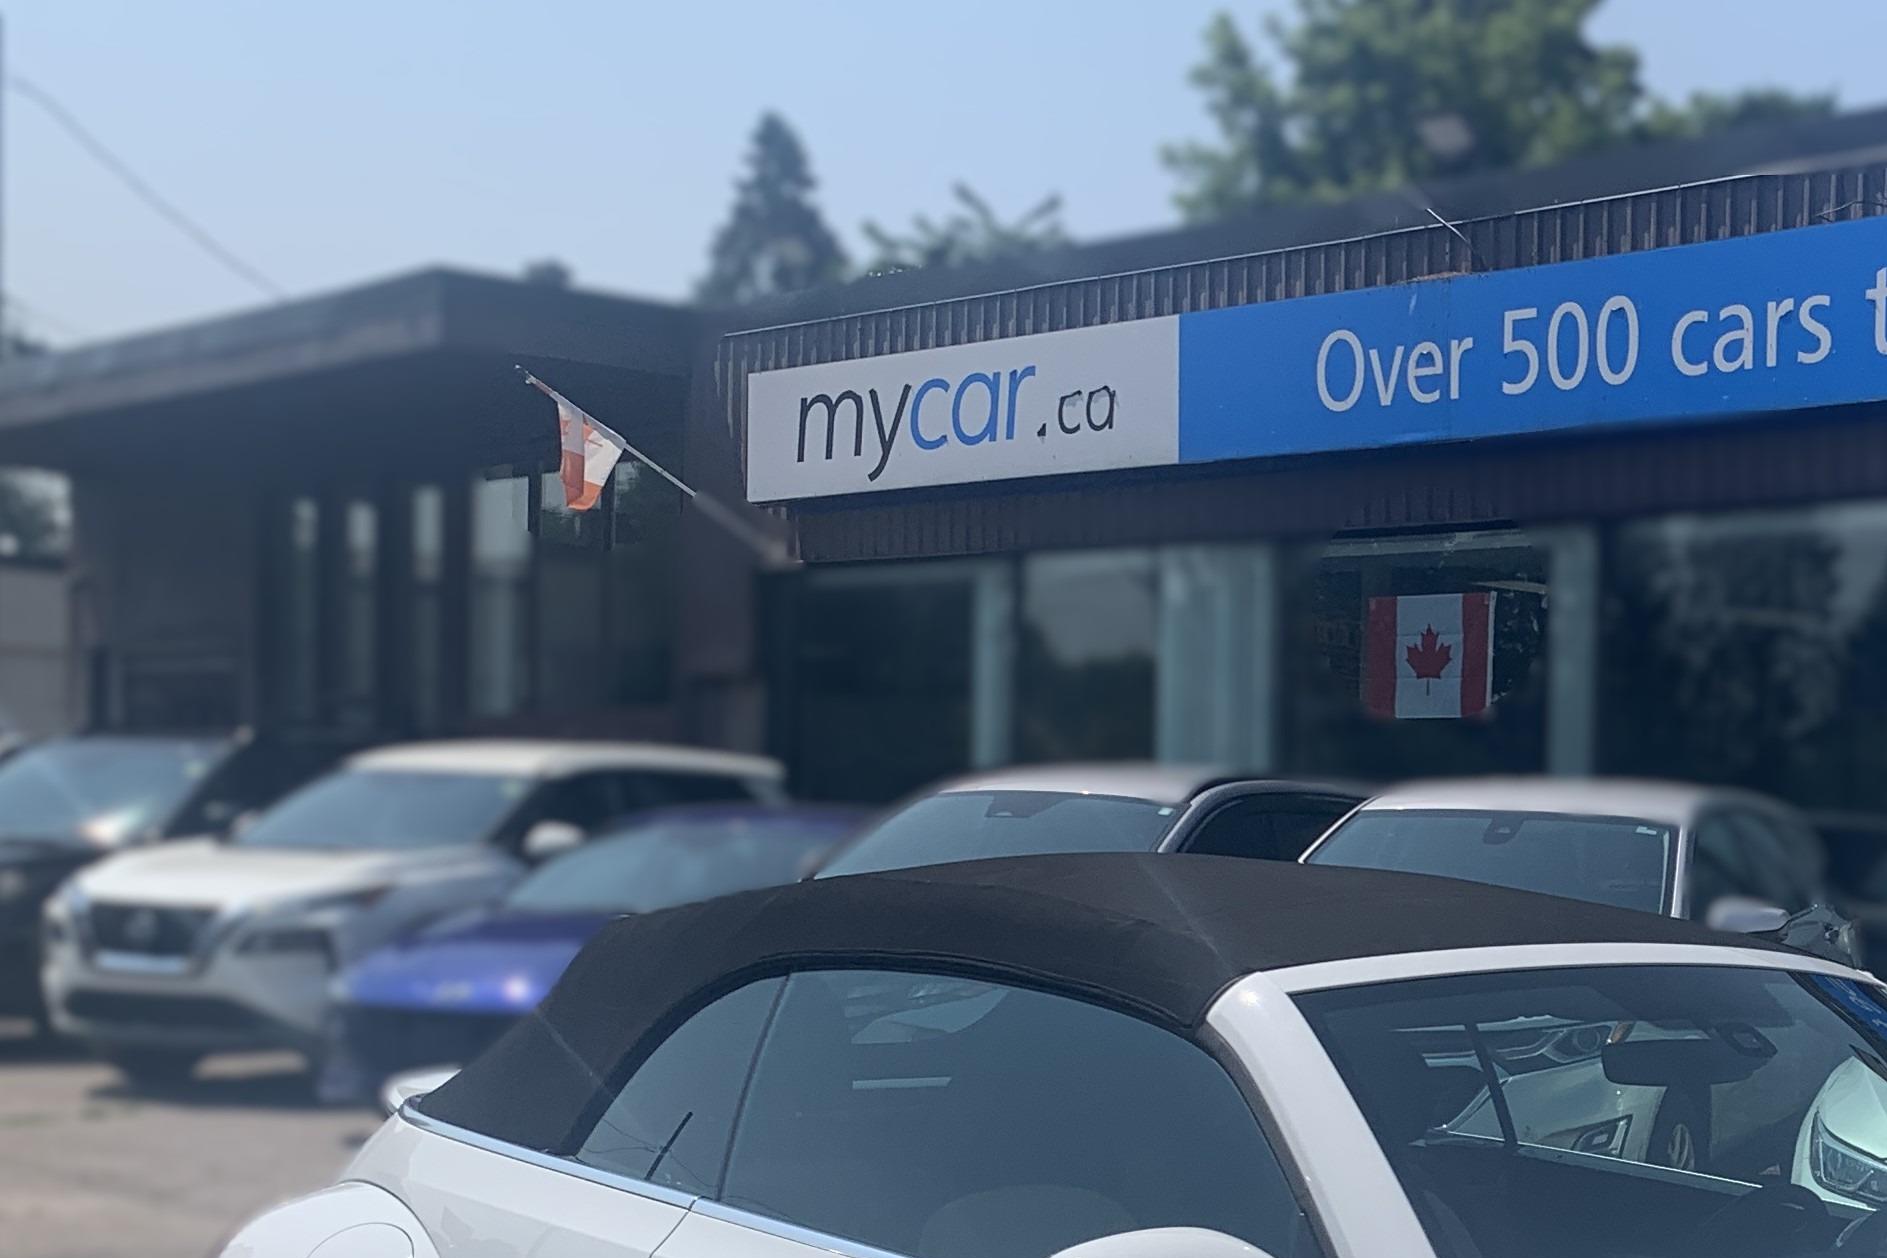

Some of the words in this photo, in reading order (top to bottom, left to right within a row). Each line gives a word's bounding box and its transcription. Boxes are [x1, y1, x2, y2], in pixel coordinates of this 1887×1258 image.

[1316, 329, 1473, 412] Over
[1501, 295, 1640, 397] 500
[1671, 294, 1832, 376] cars
[796, 364, 1116, 482] mycar.ca
